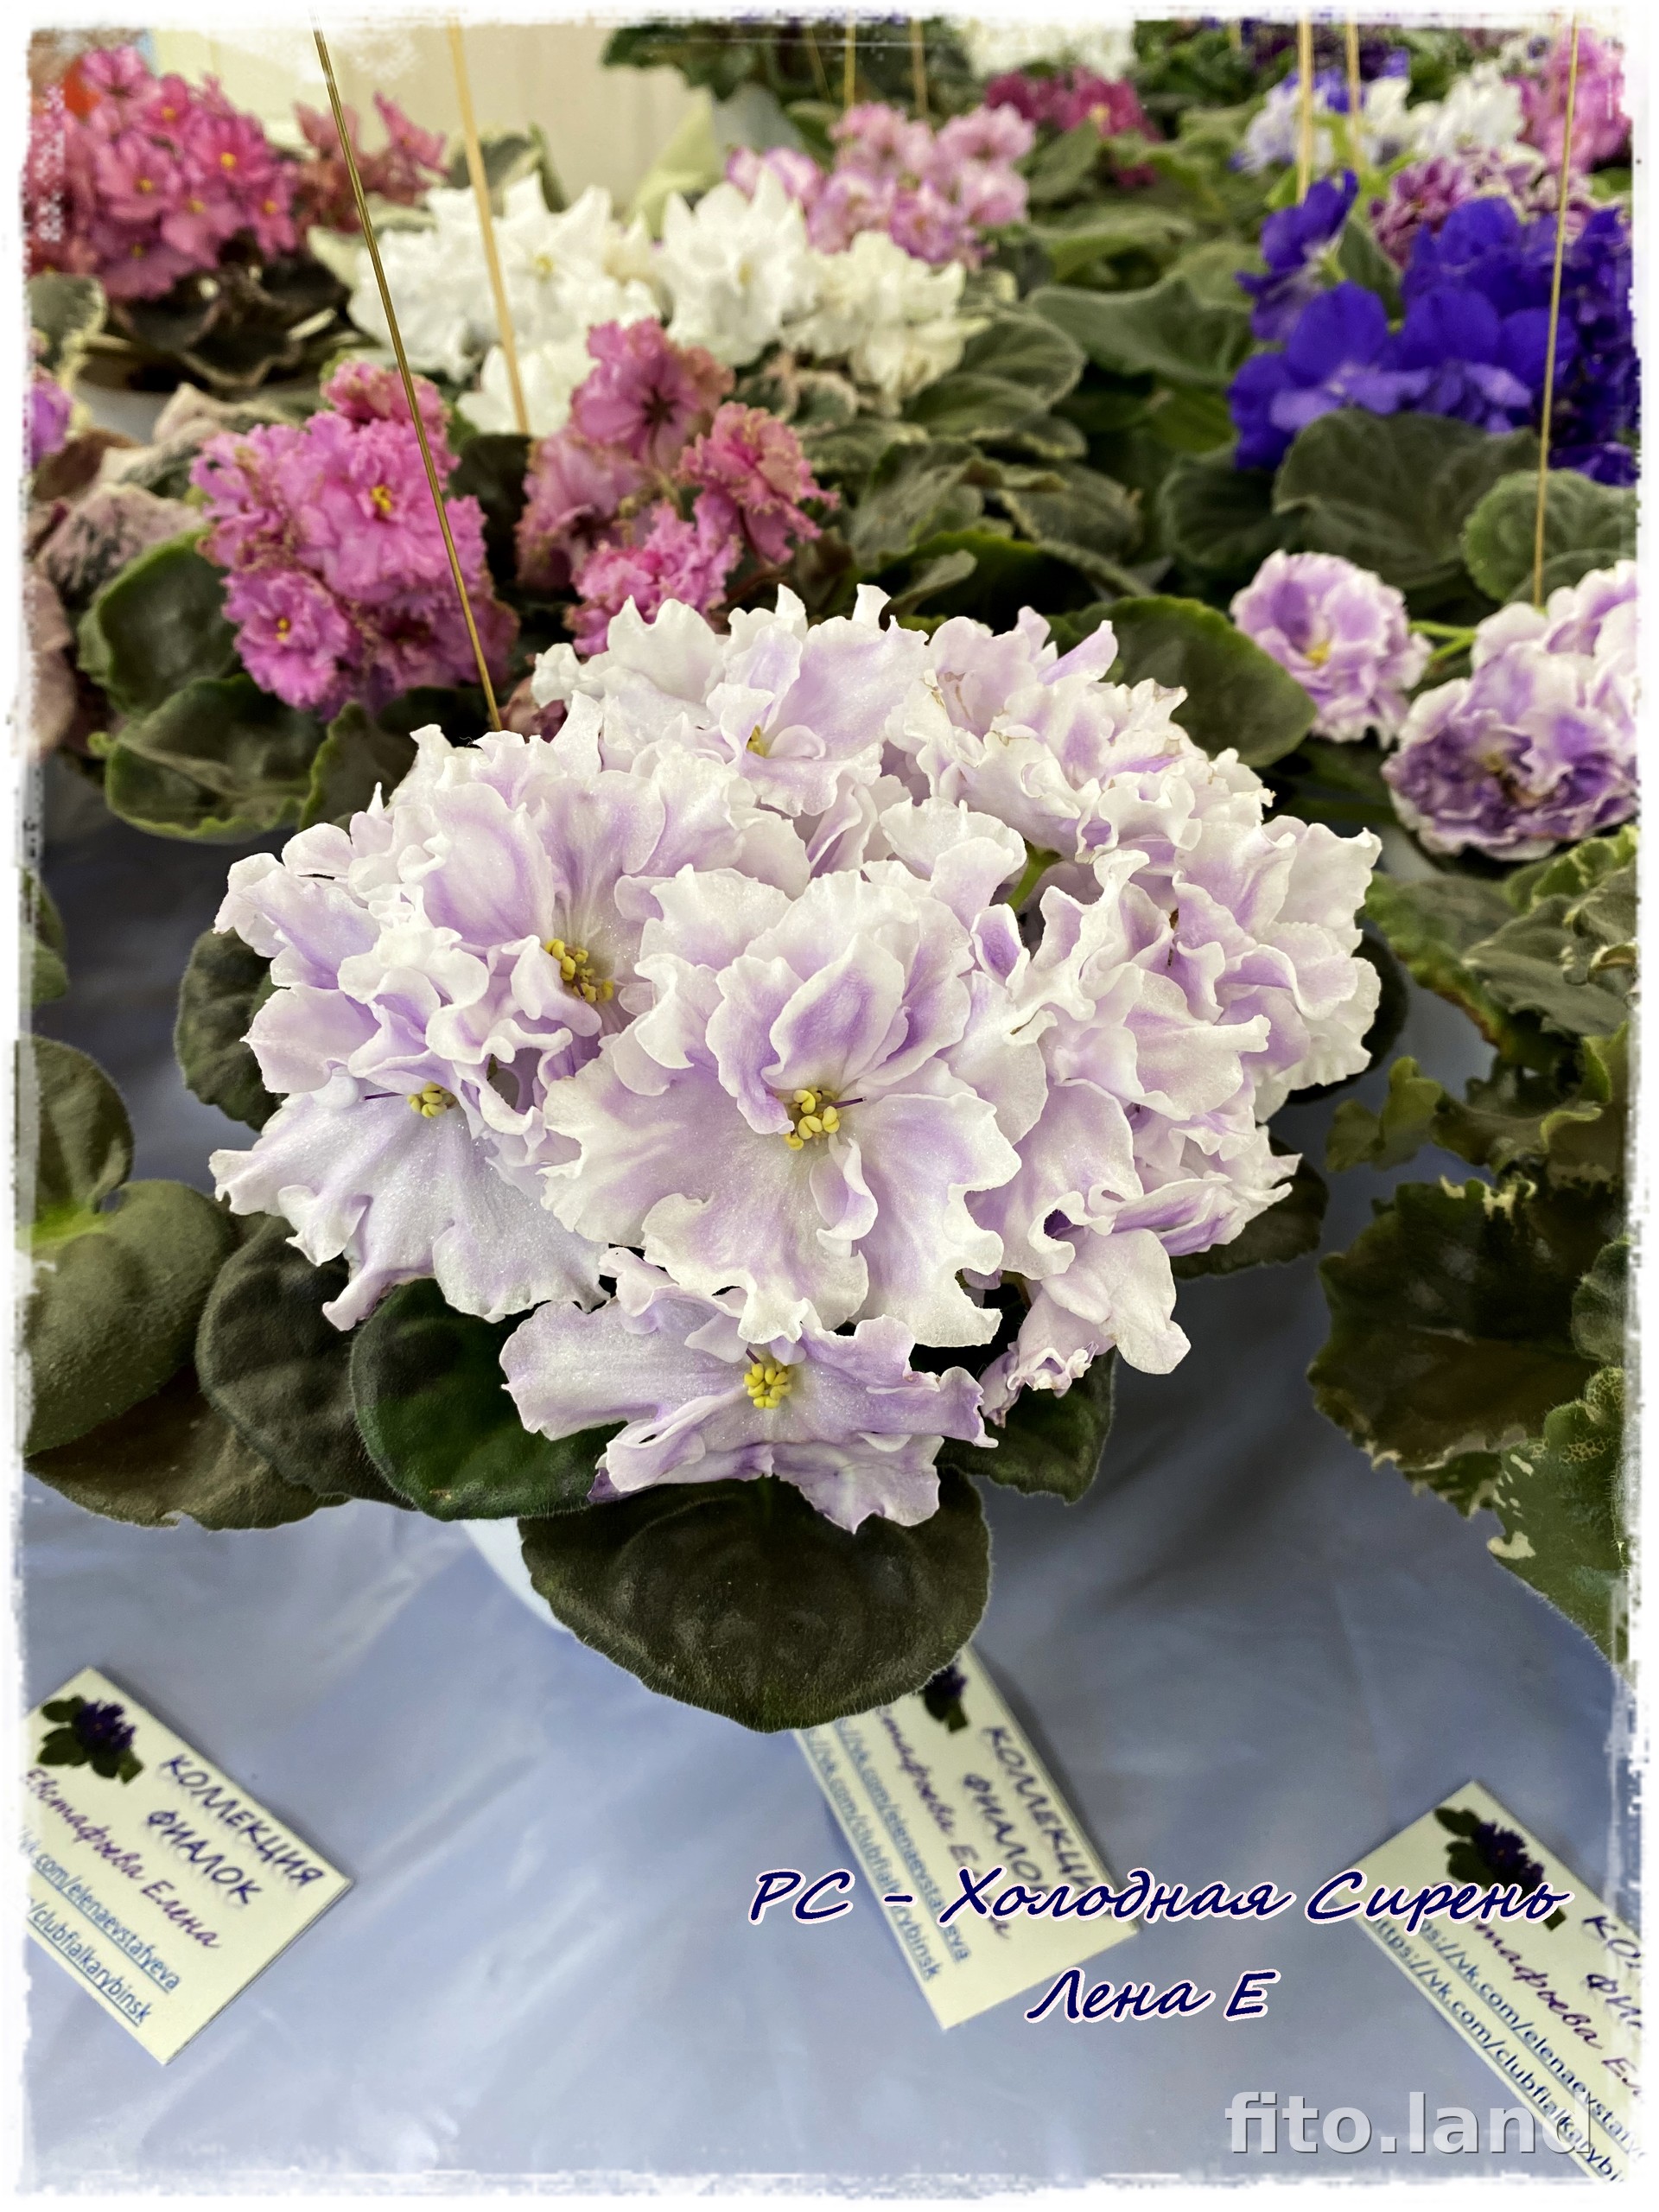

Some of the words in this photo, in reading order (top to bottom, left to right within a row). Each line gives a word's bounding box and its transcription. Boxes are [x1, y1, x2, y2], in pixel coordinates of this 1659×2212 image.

[147, 1809, 263, 1906] ФИАЛОК
[159, 1752, 326, 1887] КОЛЛЕКЦИЯ
[982, 1726, 1103, 1903] КОЛЛЕКЦИ
[141, 1879, 222, 1950] Елена
[1582, 1915, 1641, 1968] КО
